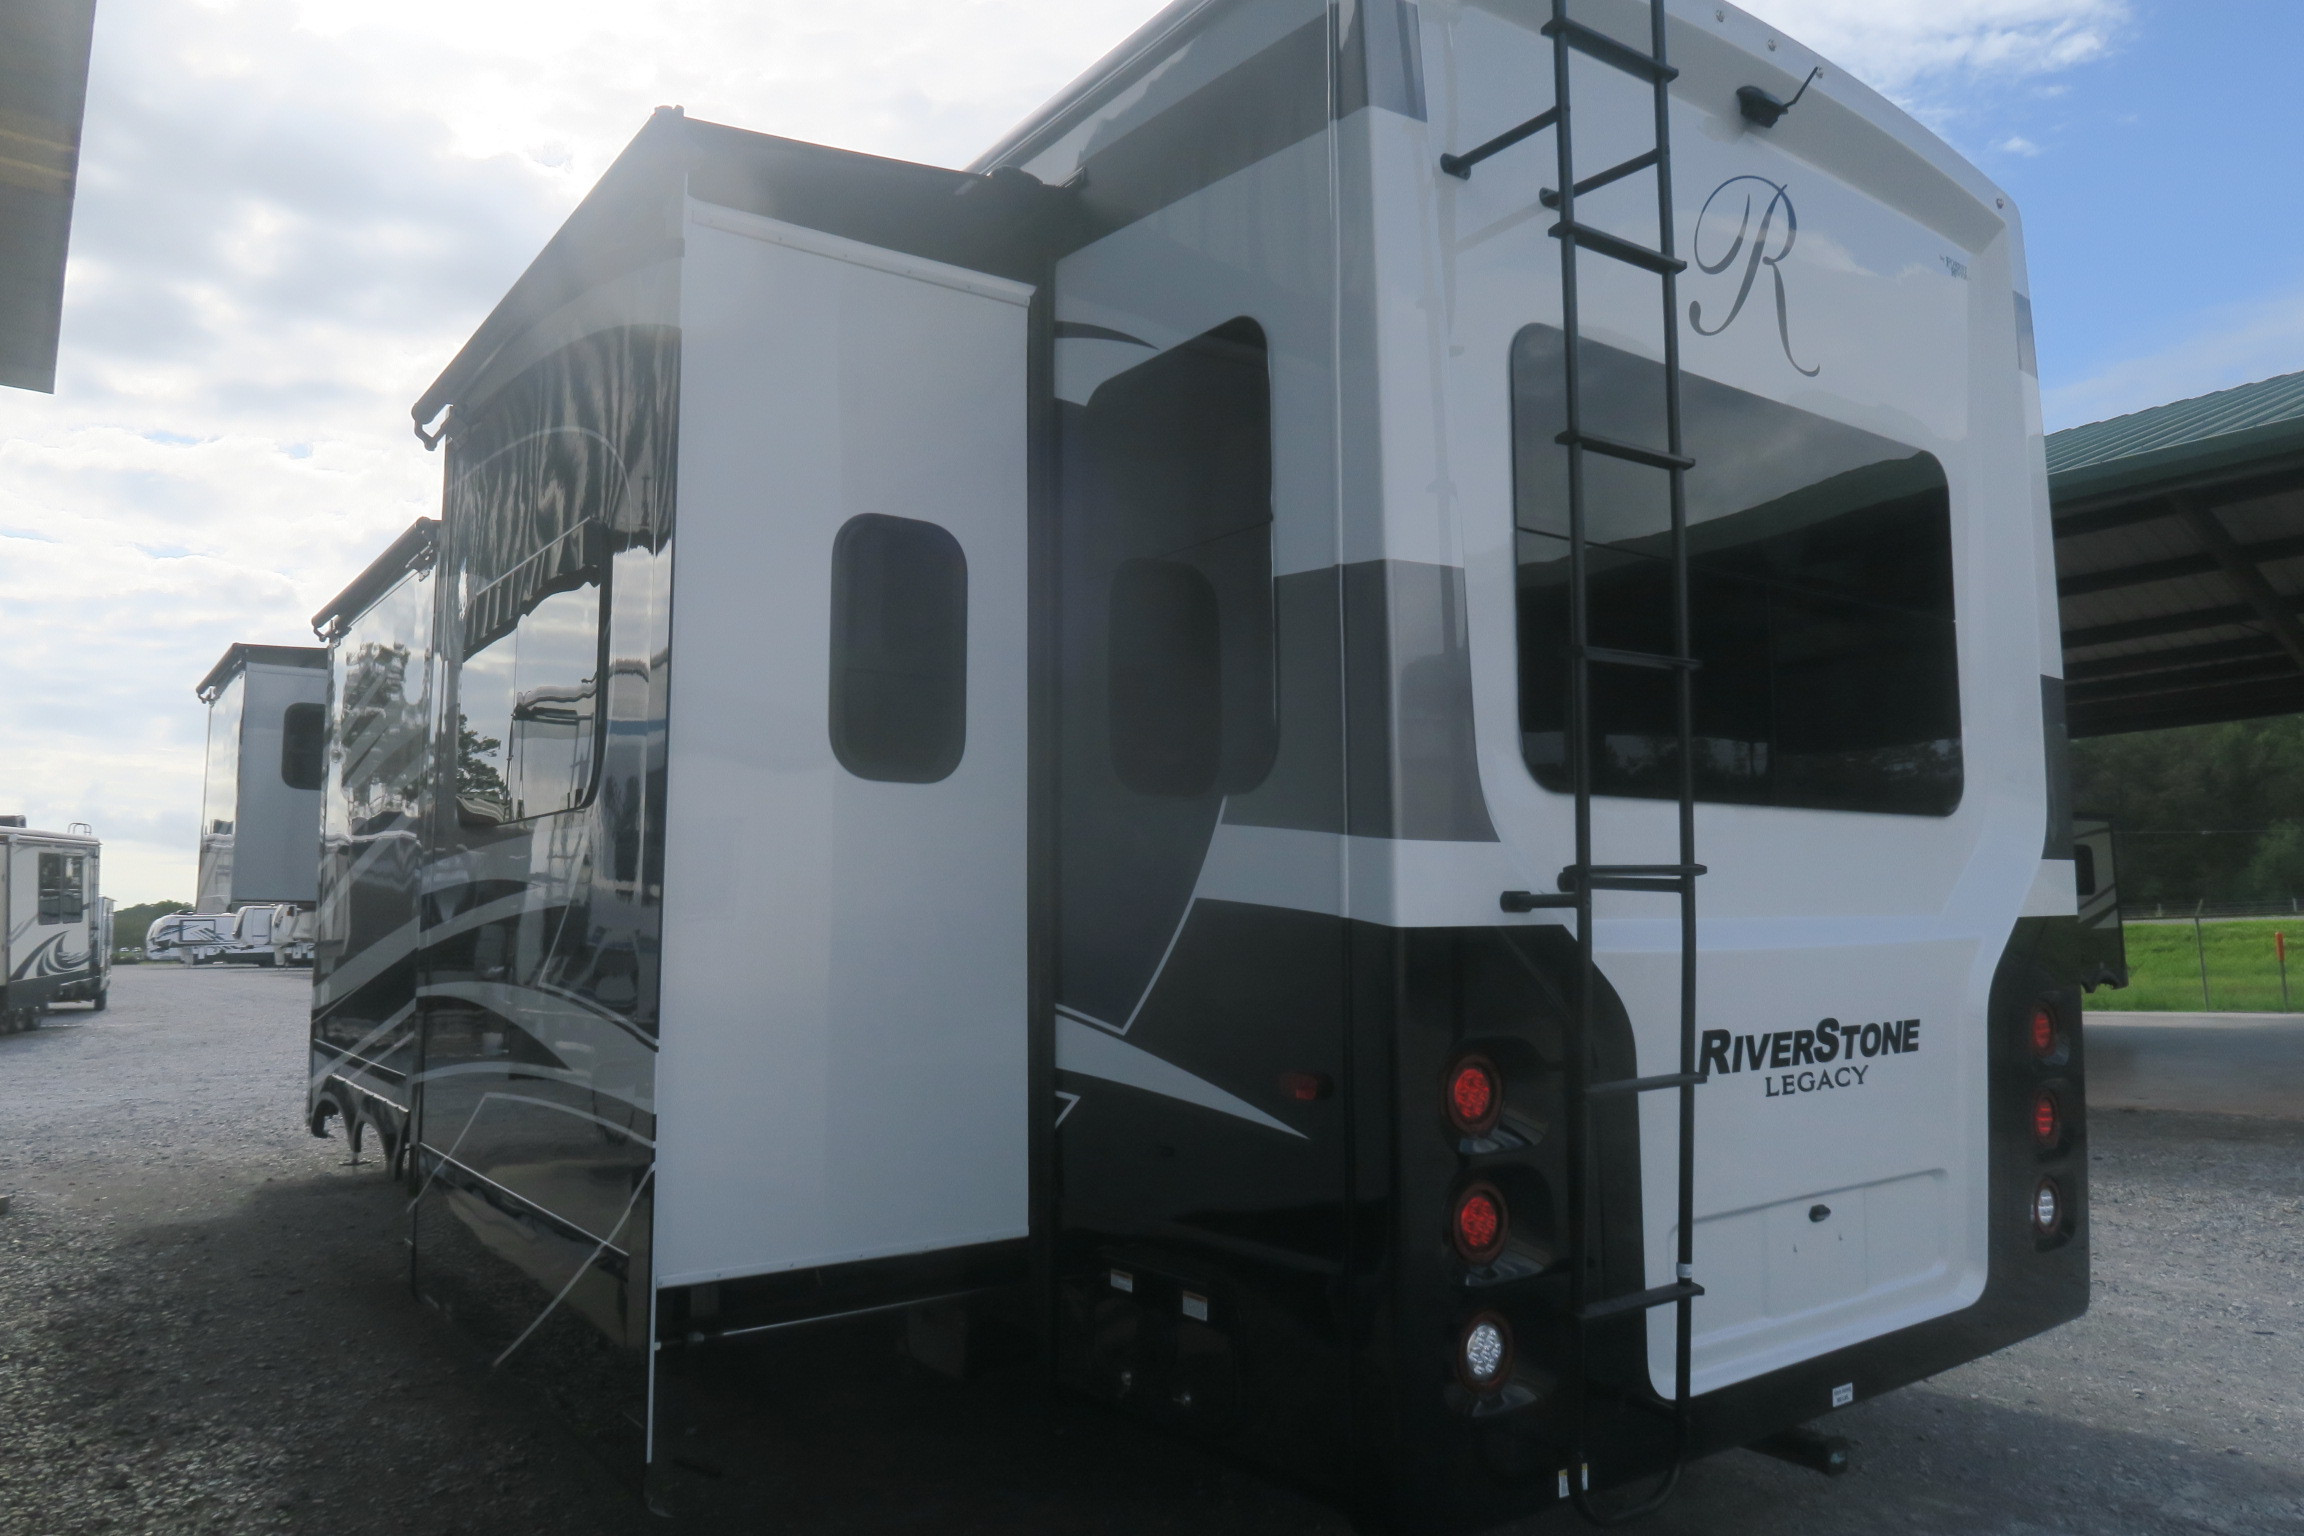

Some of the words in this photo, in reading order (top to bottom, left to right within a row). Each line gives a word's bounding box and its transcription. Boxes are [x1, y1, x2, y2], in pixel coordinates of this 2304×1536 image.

[1689, 175, 1820, 377] R
[1698, 1017, 1921, 1076] RIVERSTONE
[1765, 1065, 1869, 1098] LEGACY
